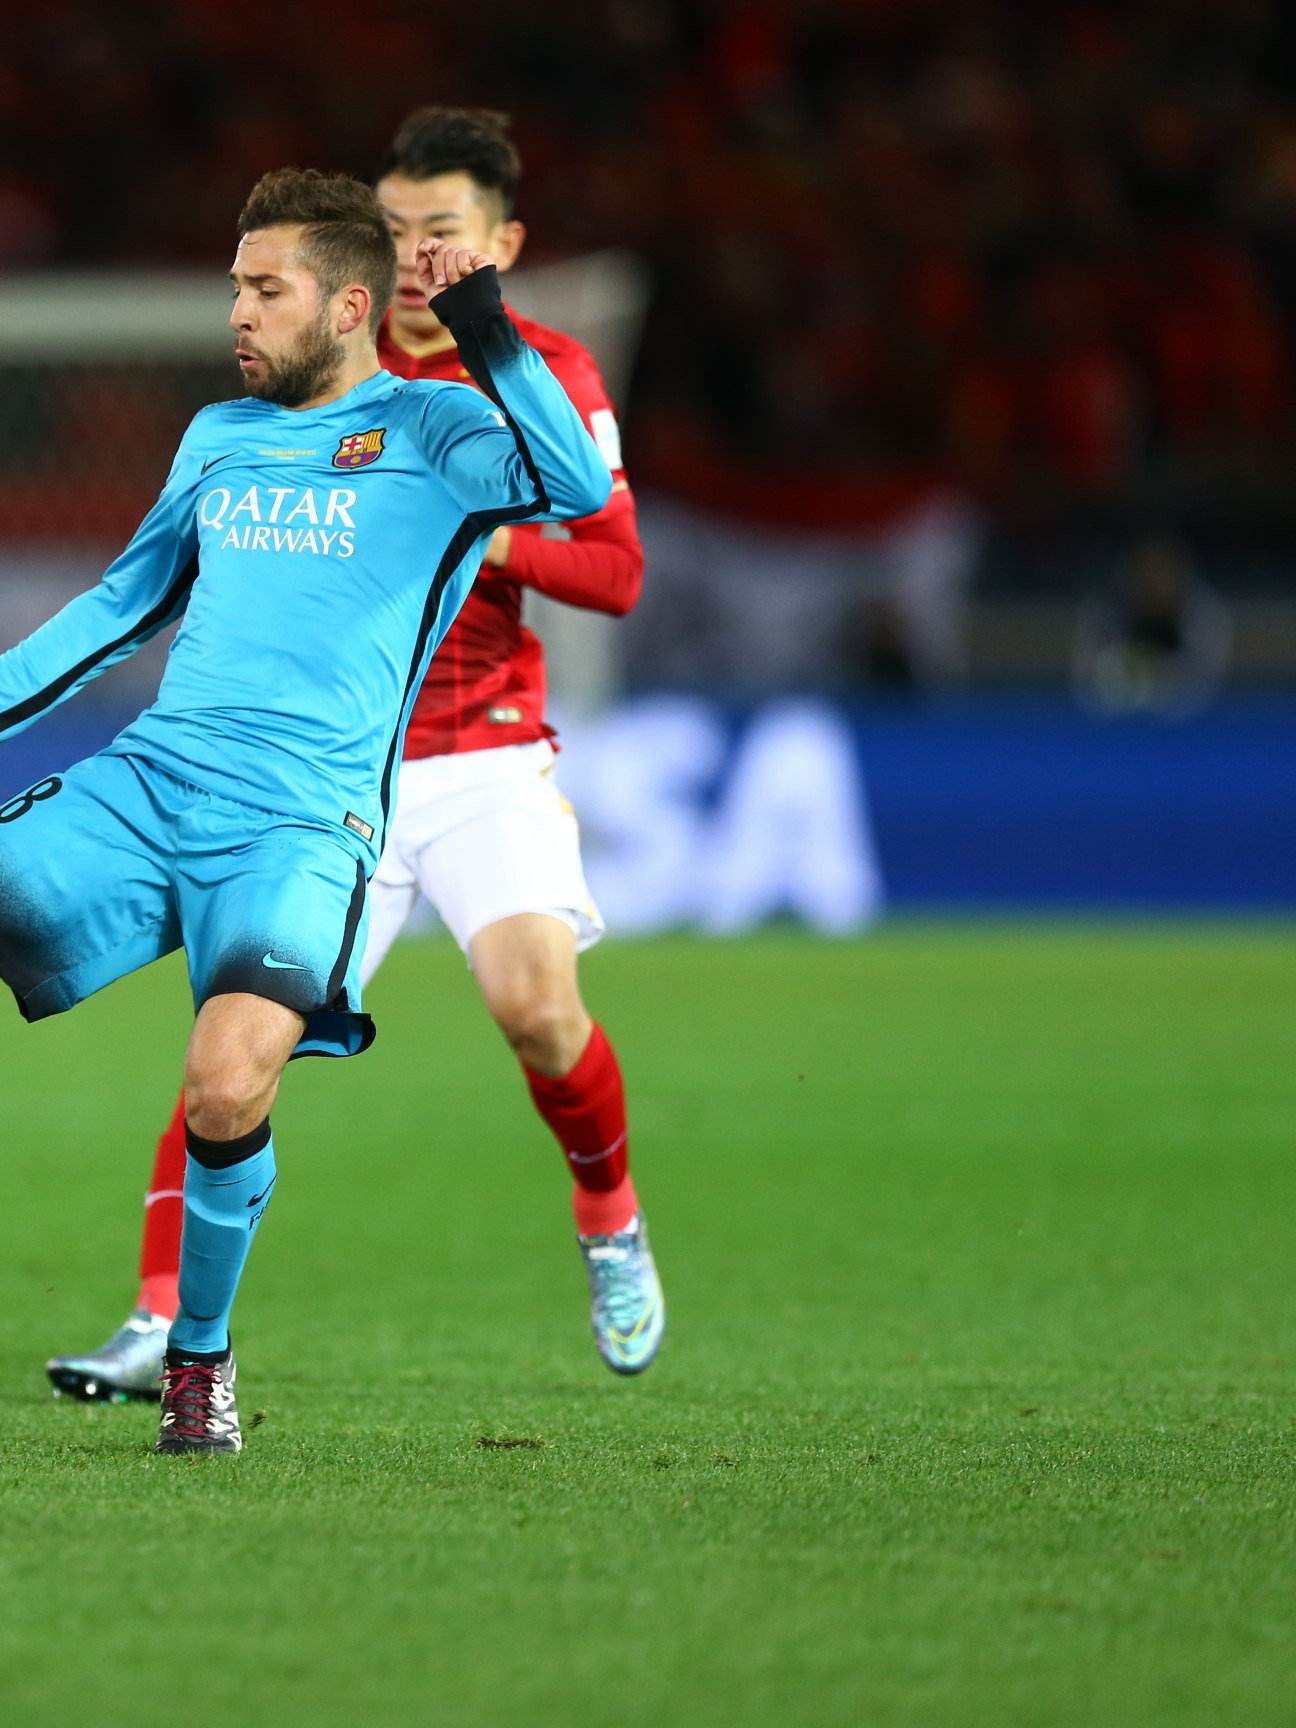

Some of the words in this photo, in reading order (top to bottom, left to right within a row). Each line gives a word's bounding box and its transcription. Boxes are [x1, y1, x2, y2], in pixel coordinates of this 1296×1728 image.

[200, 485, 357, 531] QATAR
[221, 526, 356, 558] AIRWAYS
[556, 692, 884, 938] SA
